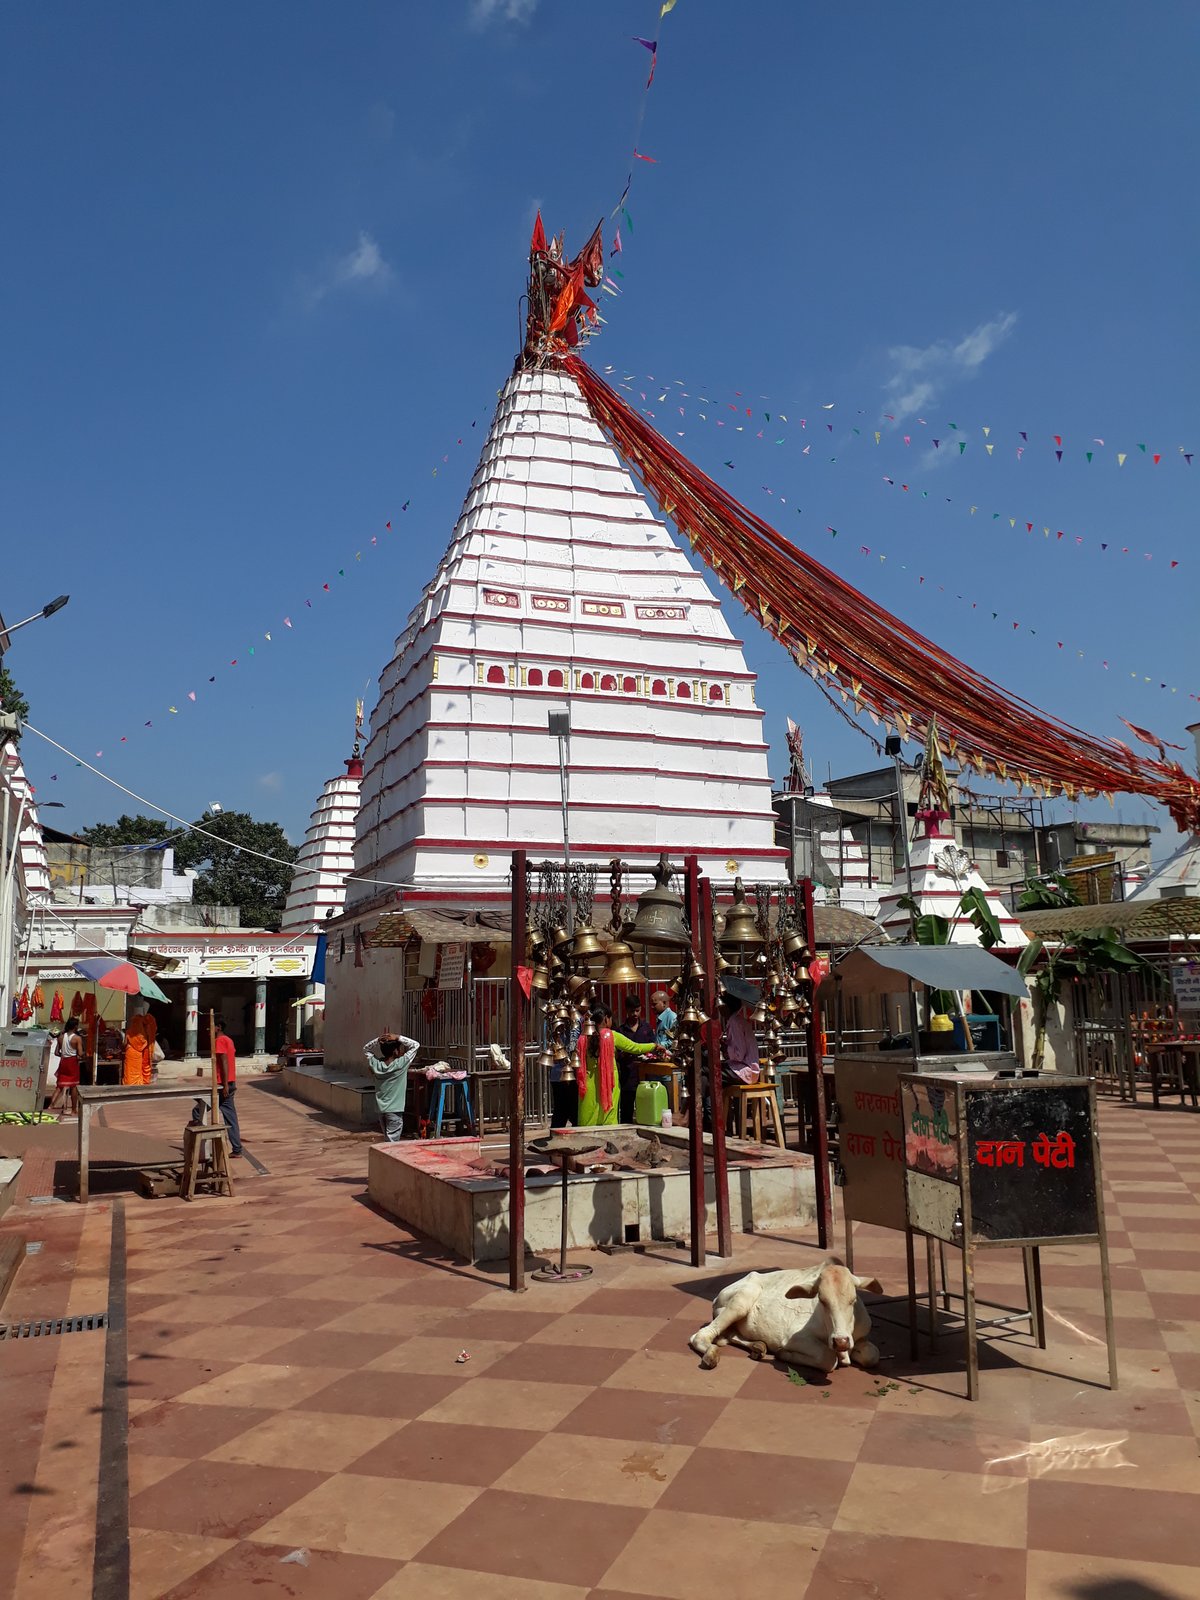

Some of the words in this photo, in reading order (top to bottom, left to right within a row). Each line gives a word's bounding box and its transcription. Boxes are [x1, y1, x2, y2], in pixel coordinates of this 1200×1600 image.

[847, 1132, 877, 1158] दान
[975, 1141, 1026, 1168] दान
[1032, 1131, 1076, 1169] पेटी
